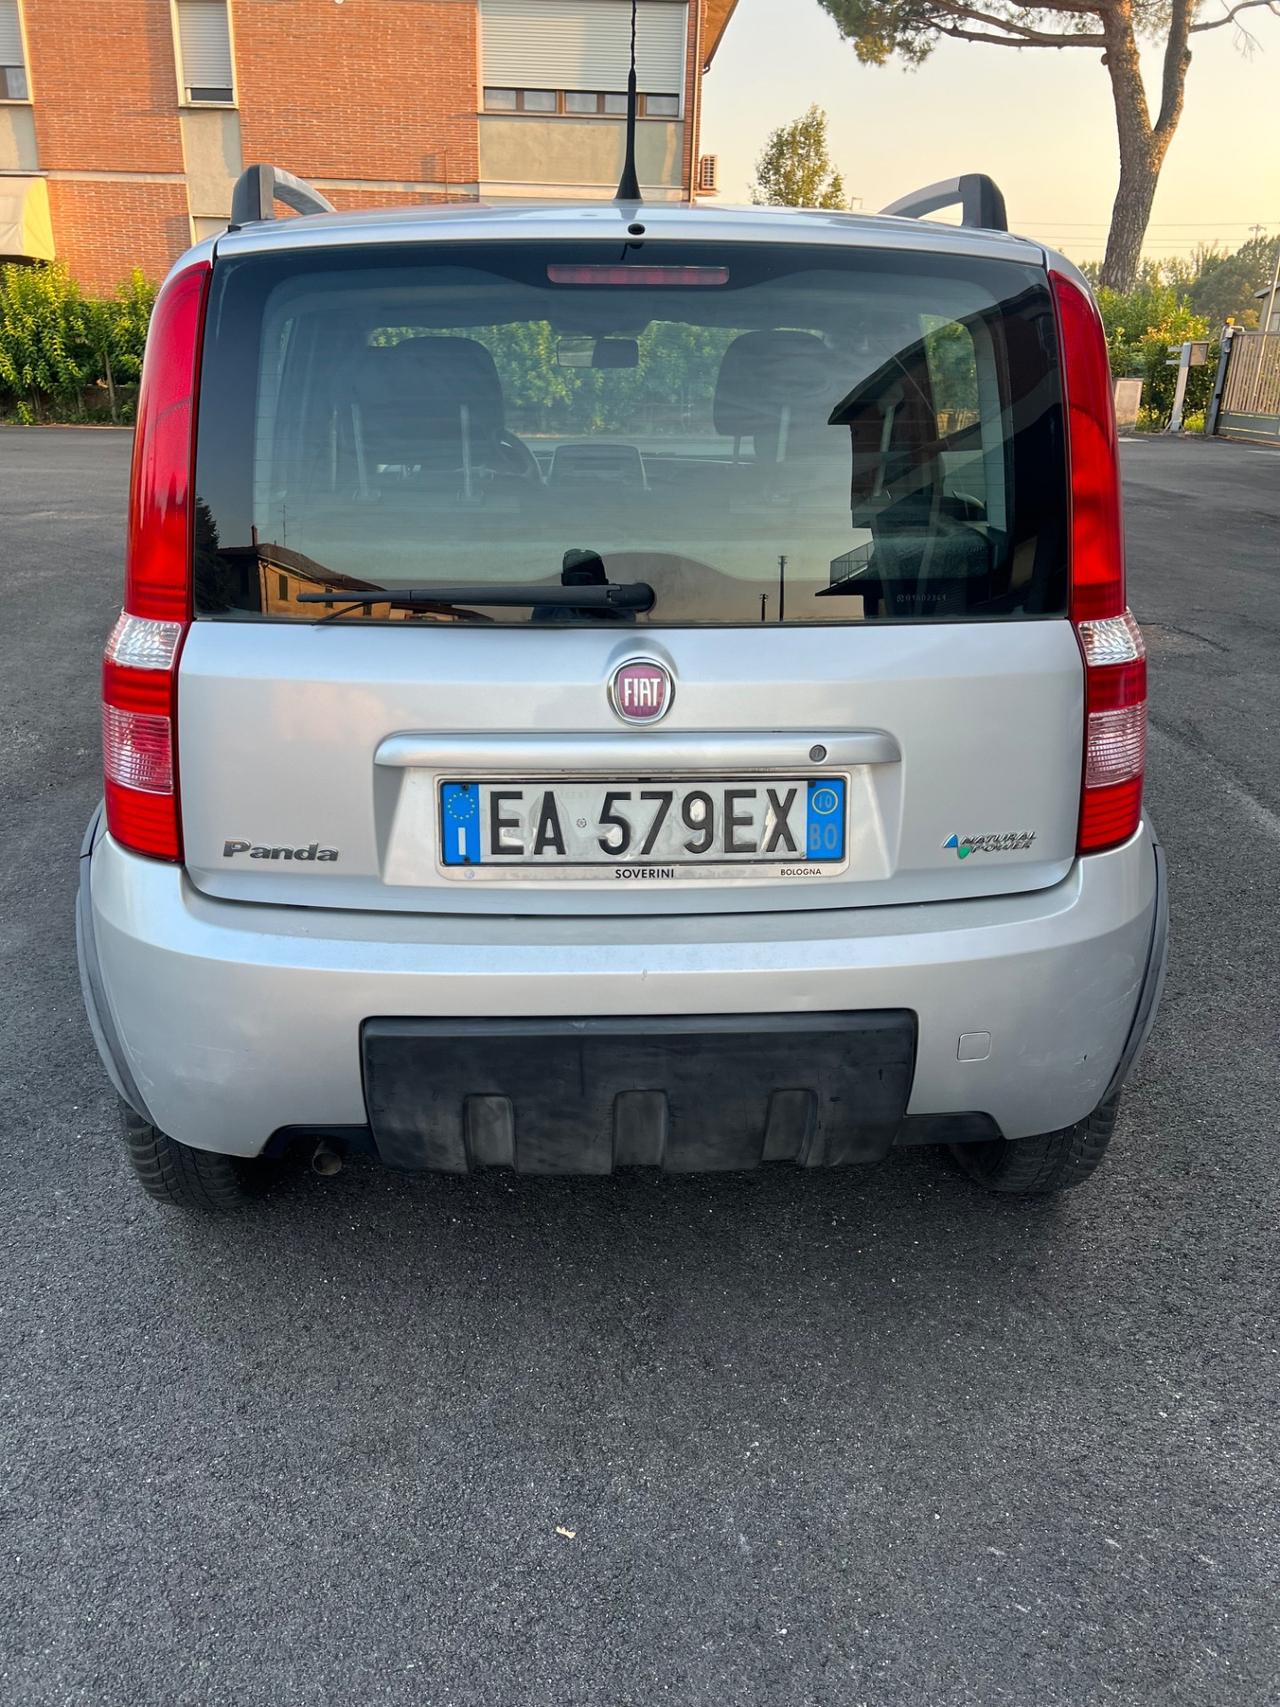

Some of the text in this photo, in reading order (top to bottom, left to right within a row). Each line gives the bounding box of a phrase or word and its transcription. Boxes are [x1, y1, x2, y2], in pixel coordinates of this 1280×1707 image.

[624, 678, 661, 707] FIAT
[490, 788, 798, 856] EA 579EX
[810, 823, 838, 851] BO
[960, 832, 1036, 845] NATURAL
[223, 840, 339, 862] Panda
[615, 868, 674, 879] SOVERINI
[780, 867, 822, 876] BOLOGNA
